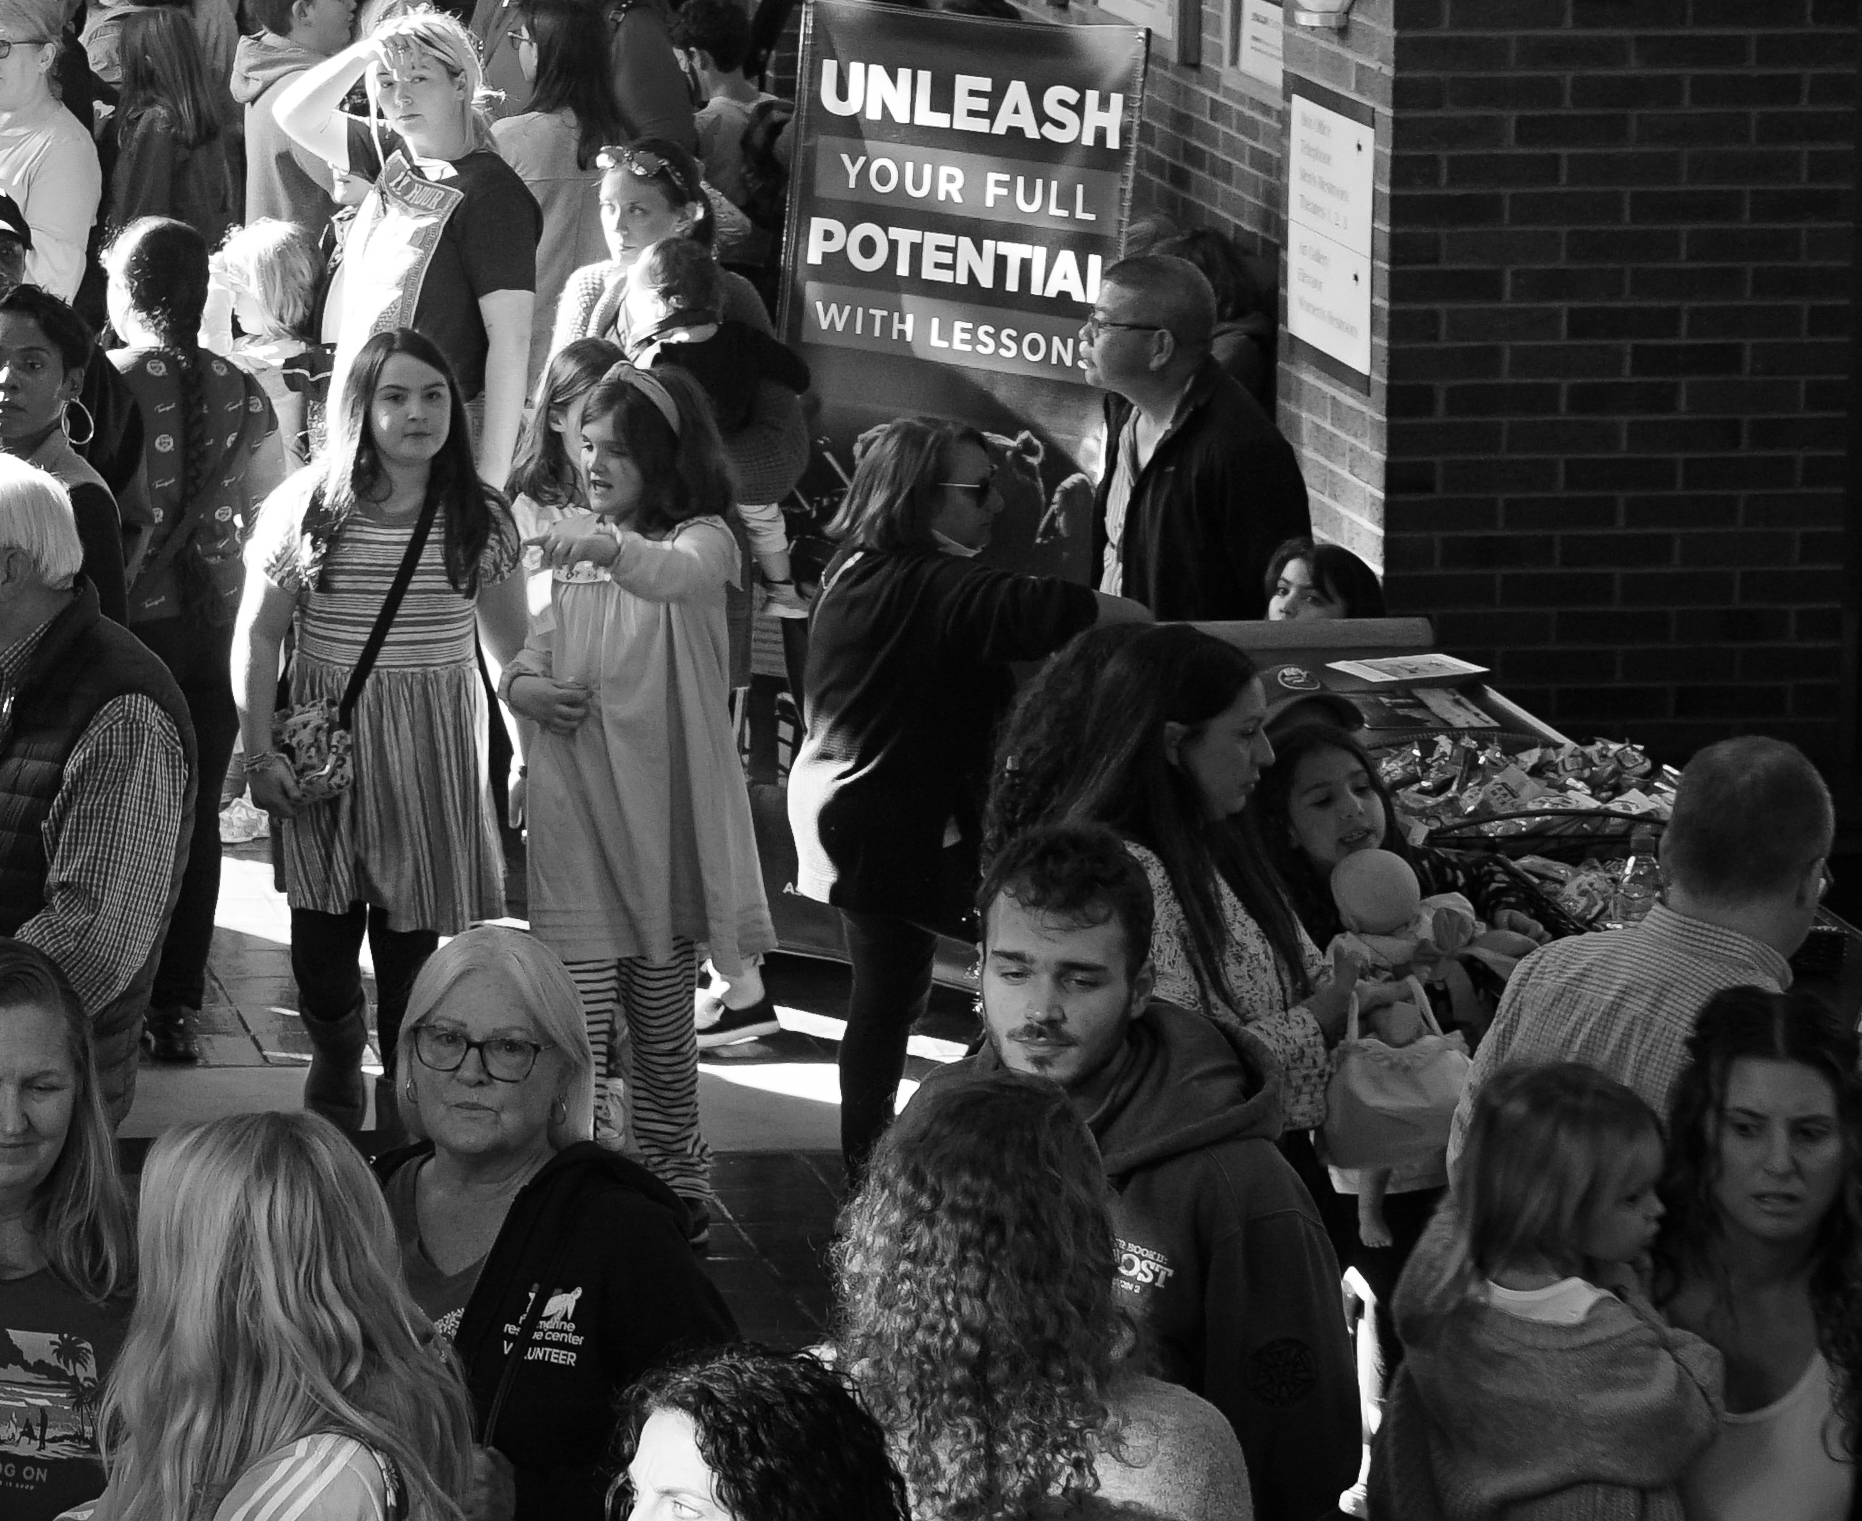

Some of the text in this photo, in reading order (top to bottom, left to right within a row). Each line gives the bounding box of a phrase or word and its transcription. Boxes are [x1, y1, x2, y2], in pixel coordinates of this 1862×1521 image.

[819, 58, 1125, 150] UNLEASH
[840, 153, 1097, 221] YOUR FULL
[815, 300, 915, 343] WITH
[503, 1340, 577, 1367] VUNTEER
[544, 1331, 585, 1345] center
[22, 1466, 48, 1483] ON
